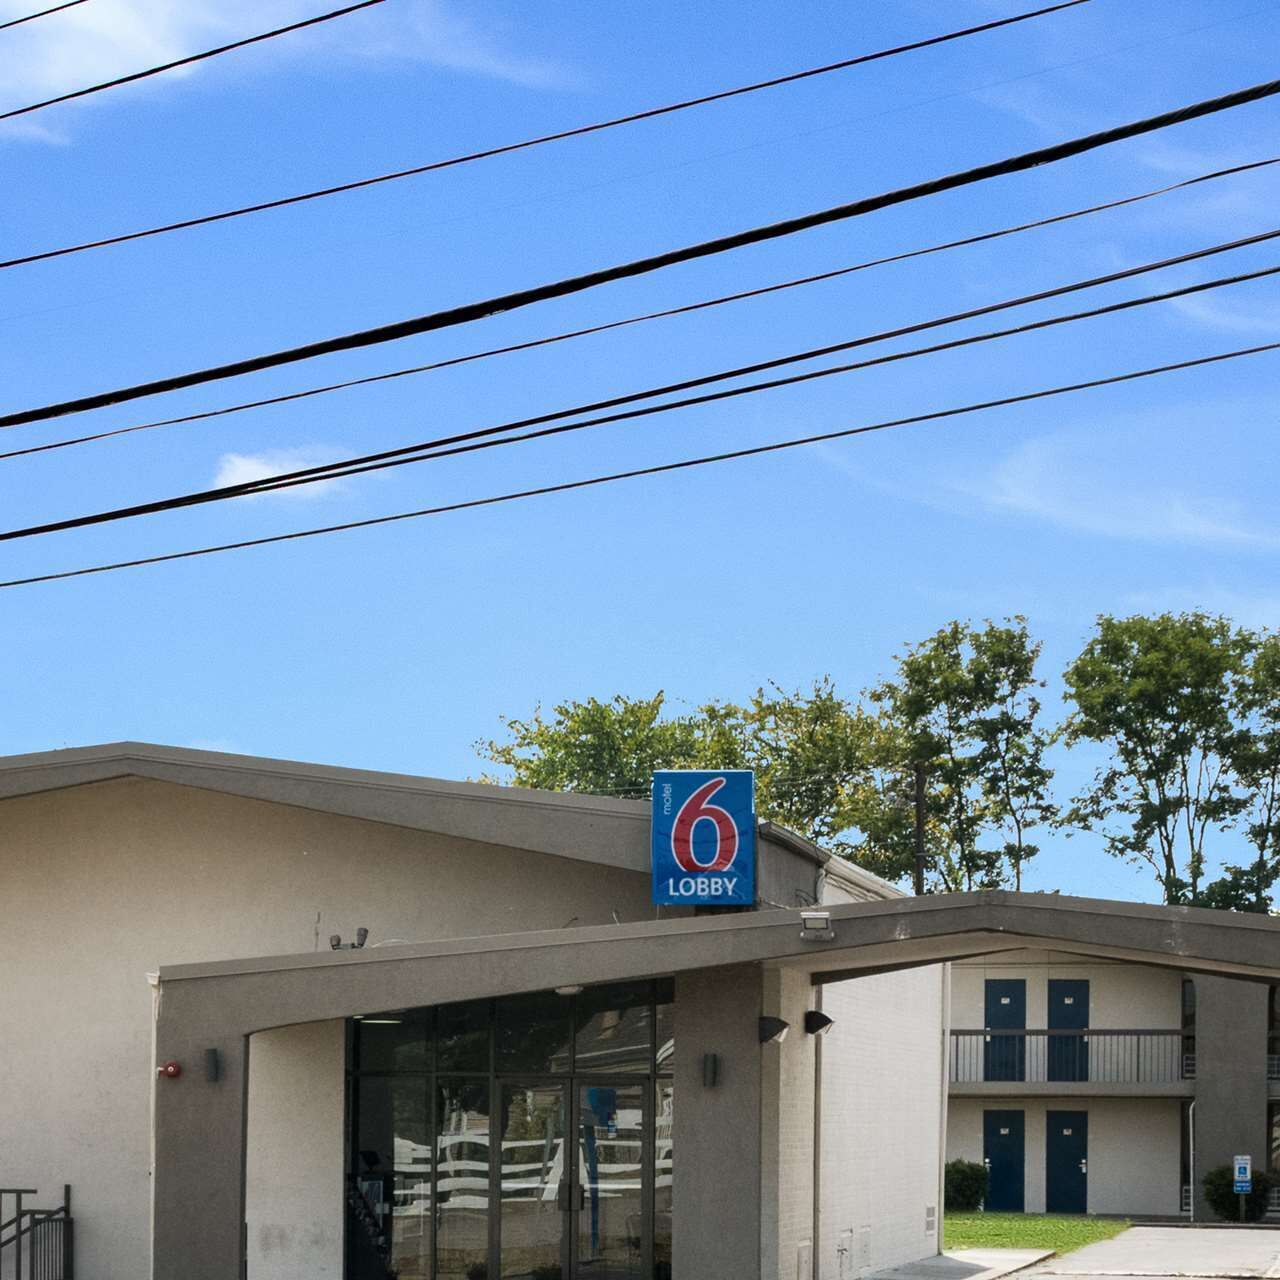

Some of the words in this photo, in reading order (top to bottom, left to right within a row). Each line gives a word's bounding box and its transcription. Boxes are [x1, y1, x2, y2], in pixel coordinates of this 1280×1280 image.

[663, 783, 672, 815] motel
[672, 777, 739, 872] 6
[668, 877, 737, 896] LOBBY
